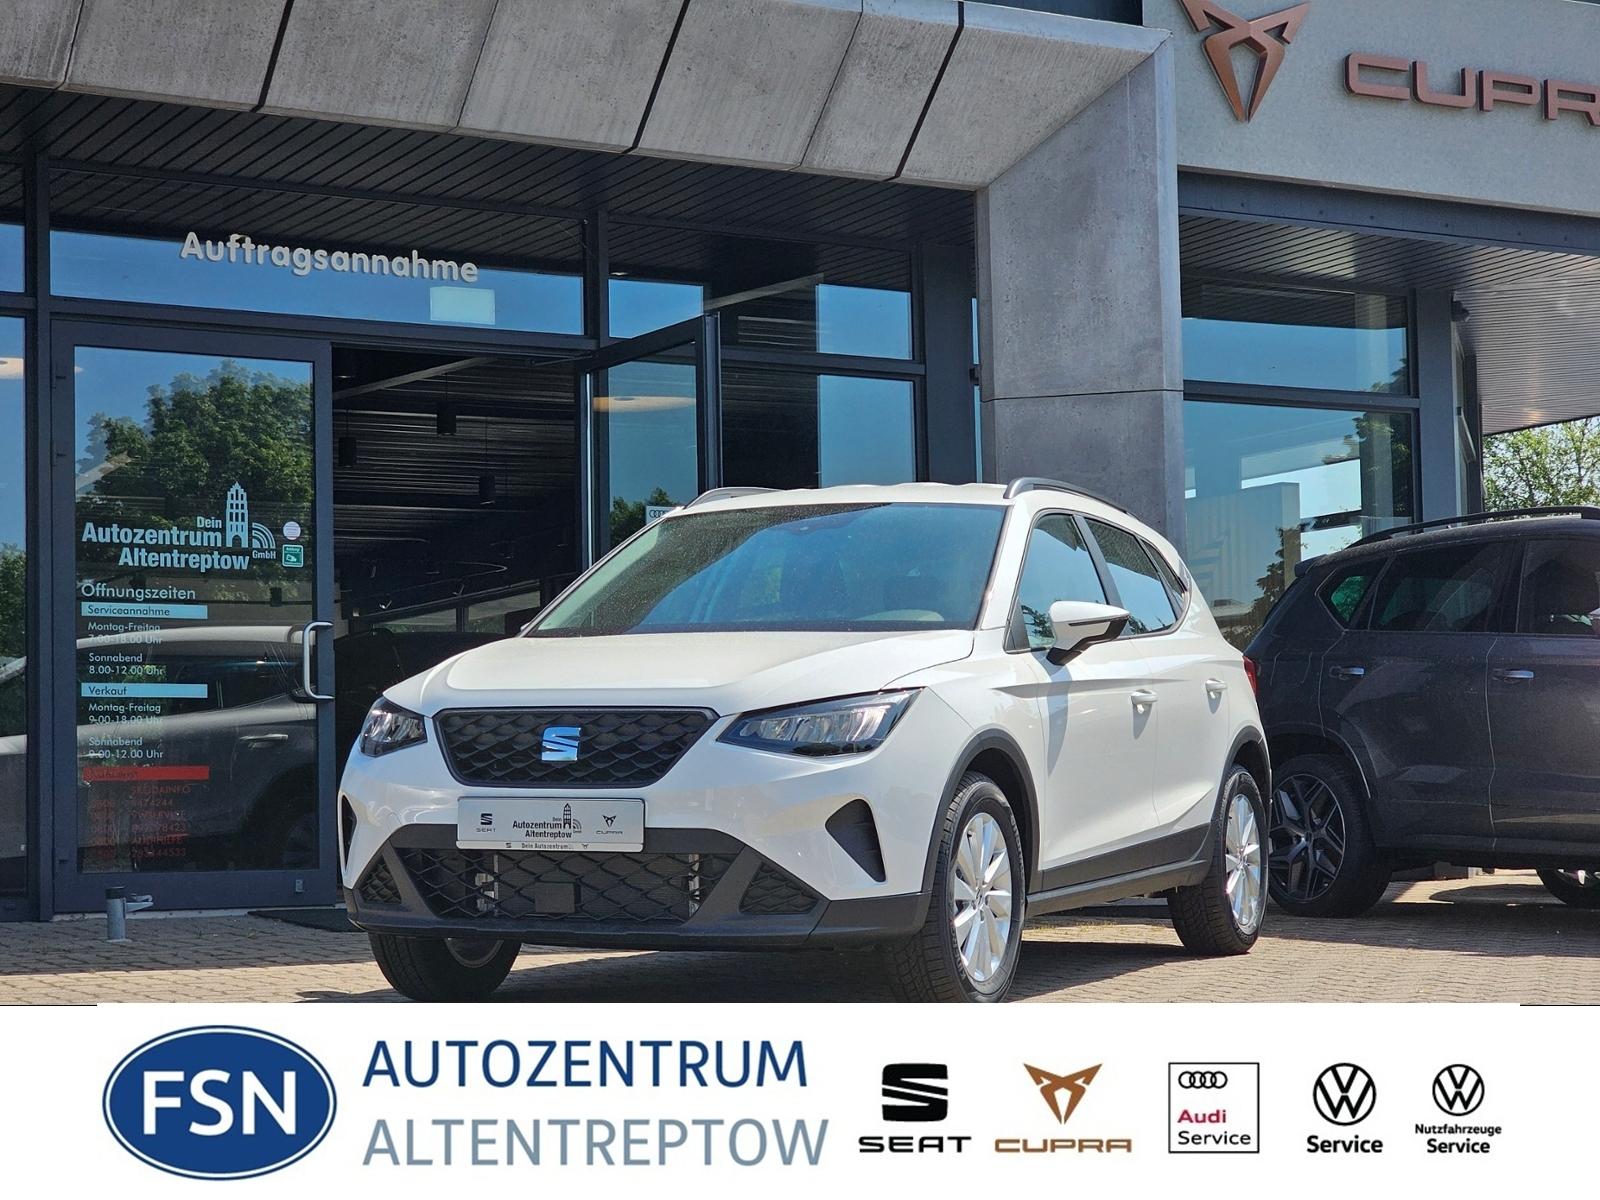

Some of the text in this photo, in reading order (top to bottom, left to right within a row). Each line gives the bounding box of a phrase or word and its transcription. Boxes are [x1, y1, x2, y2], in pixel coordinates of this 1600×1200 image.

[181, 231, 479, 283] Auftragsannahme
[197, 516, 222, 529] Dein
[82, 522, 222, 547] Autozentrum
[119, 547, 250, 573] Altentreptow
[252, 550, 276, 559] GmbH
[81, 583, 196, 601] Öffnungszeiten
[87, 605, 170, 616] Serviceannahme
[87, 621, 160, 633] Montag-Freitag
[145, 634, 162, 645] Uhr
[88, 652, 143, 662] Sonnabend
[88, 665, 163, 675] 8.00-12.00 Uhr
[88, 686, 127, 696] Verkauf
[88, 703, 161, 714] Montag-Freitag
[145, 714, 162, 725] Uhr
[88, 737, 143, 747] Sonnabend
[146, 749, 164, 759] Uhr
[512, 820, 563, 830] Autozentrum
[525, 830, 572, 839] Altentreptow
